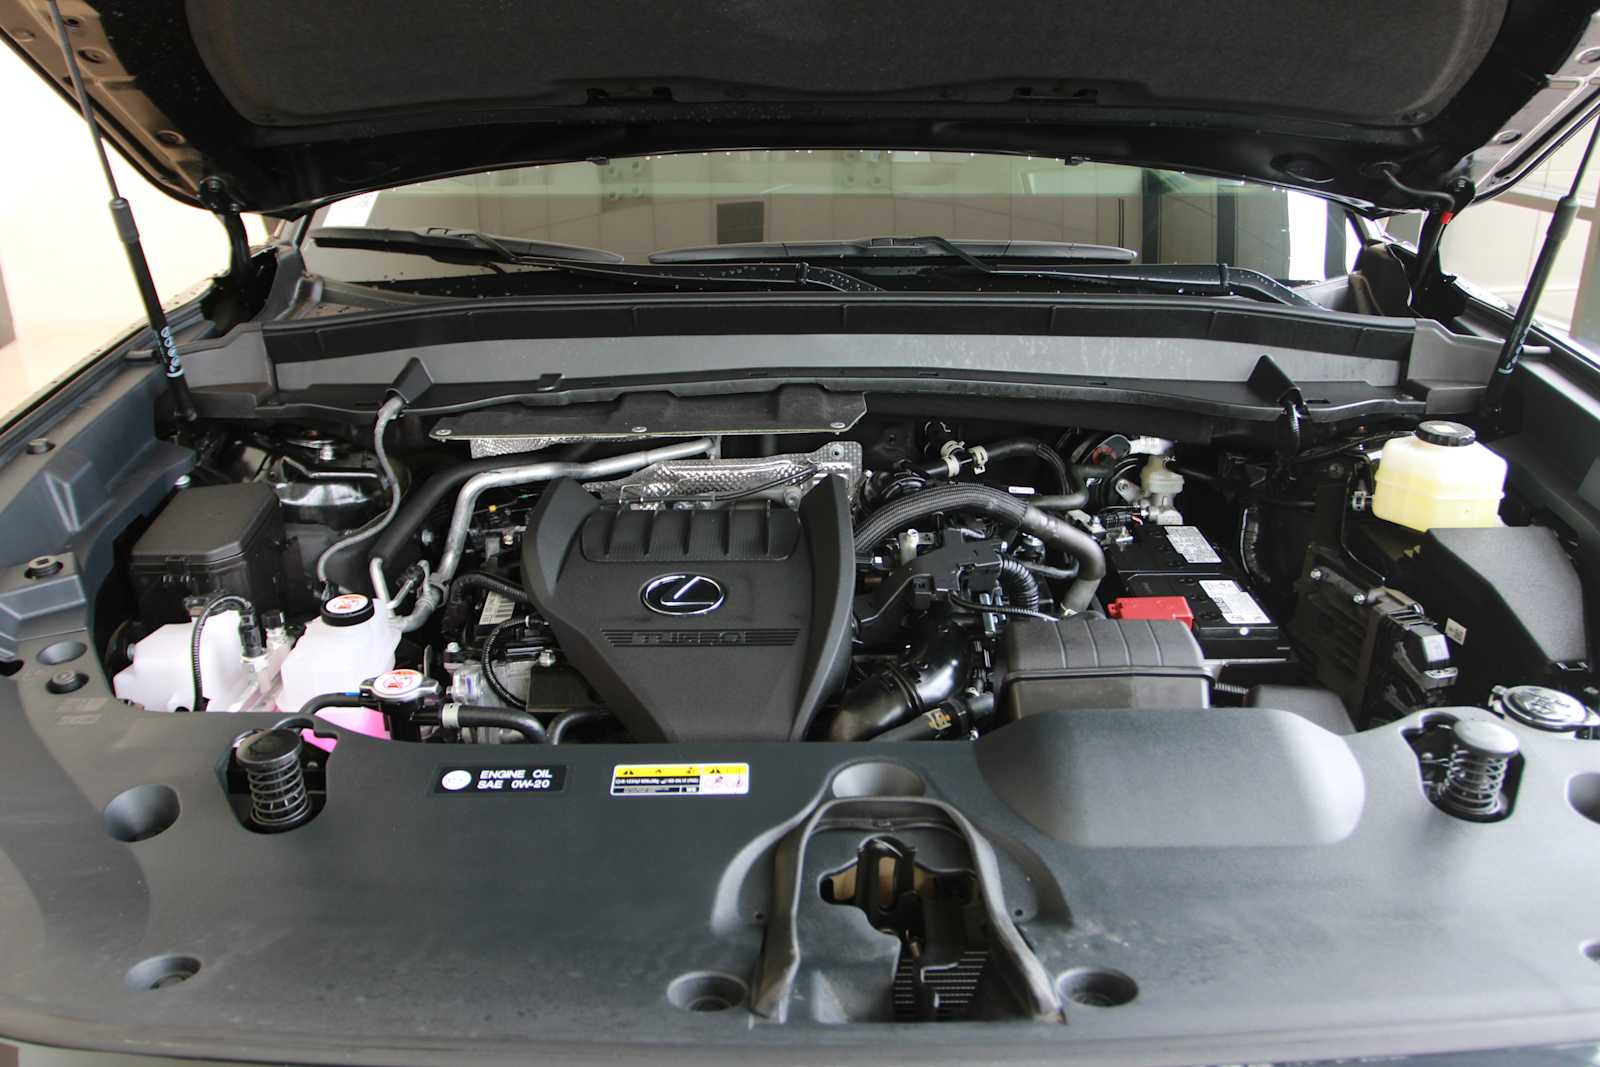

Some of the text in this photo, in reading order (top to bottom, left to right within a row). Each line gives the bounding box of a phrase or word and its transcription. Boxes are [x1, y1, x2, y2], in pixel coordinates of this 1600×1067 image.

[480, 769, 553, 779] ENGINE OIL
[477, 779, 551, 789] SAE 0W-20
